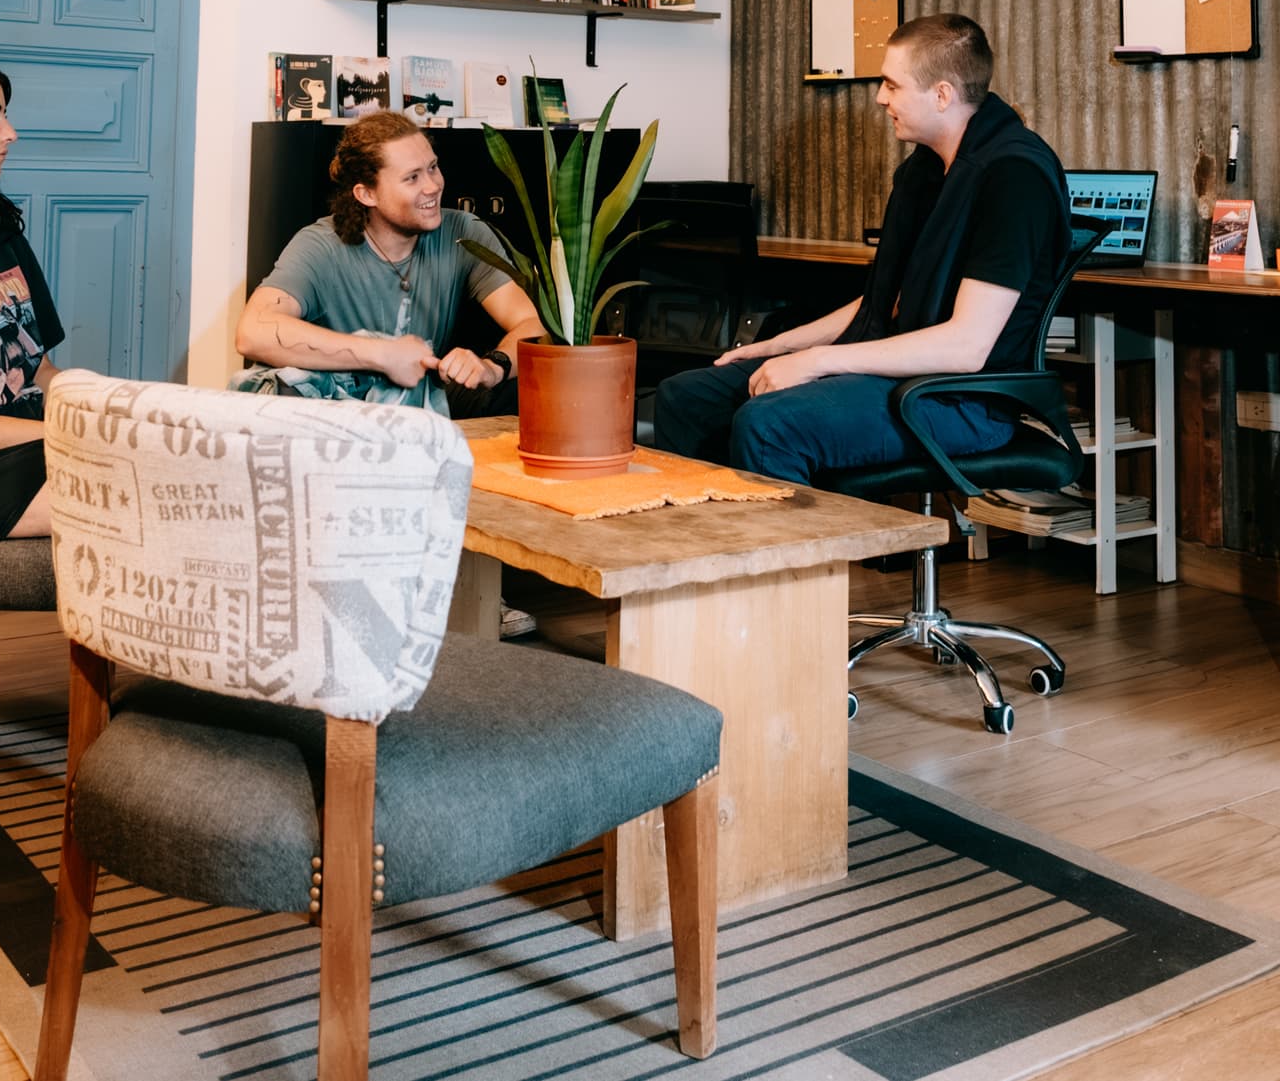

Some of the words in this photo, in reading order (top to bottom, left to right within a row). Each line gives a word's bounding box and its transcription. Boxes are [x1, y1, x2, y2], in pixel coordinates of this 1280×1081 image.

[152, 483, 219, 501] GREAT
[158, 503, 244, 521] BRITAIN
[185, 559, 249, 579] IMPORTANT
[120, 565, 218, 611] 120774
[145, 603, 218, 629] CAUTION
[102, 608, 220, 652] MANUFACTURE
